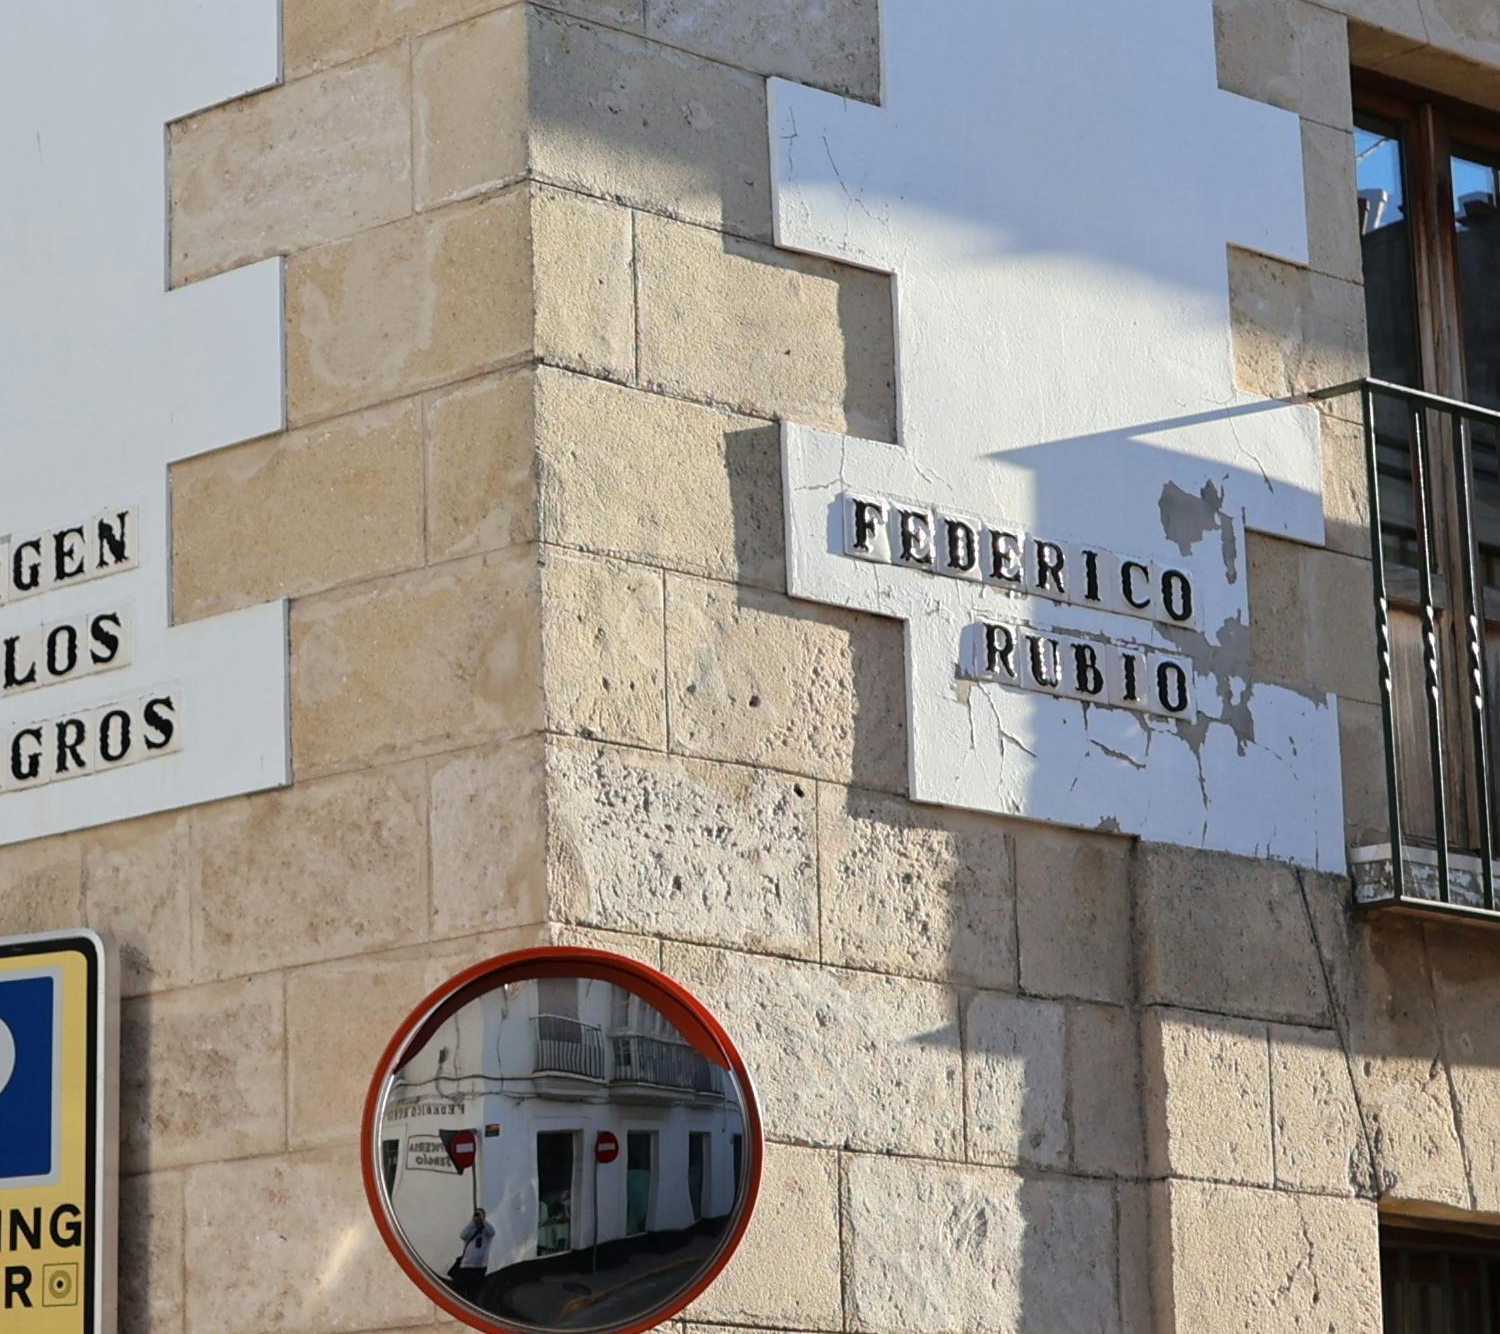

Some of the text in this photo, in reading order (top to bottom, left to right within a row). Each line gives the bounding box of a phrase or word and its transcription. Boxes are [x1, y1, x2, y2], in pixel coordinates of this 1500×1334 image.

[850, 496, 1193, 622] FEDERICO
[2, 611, 122, 691] LOS
[983, 619, 1187, 713] RUBIO
